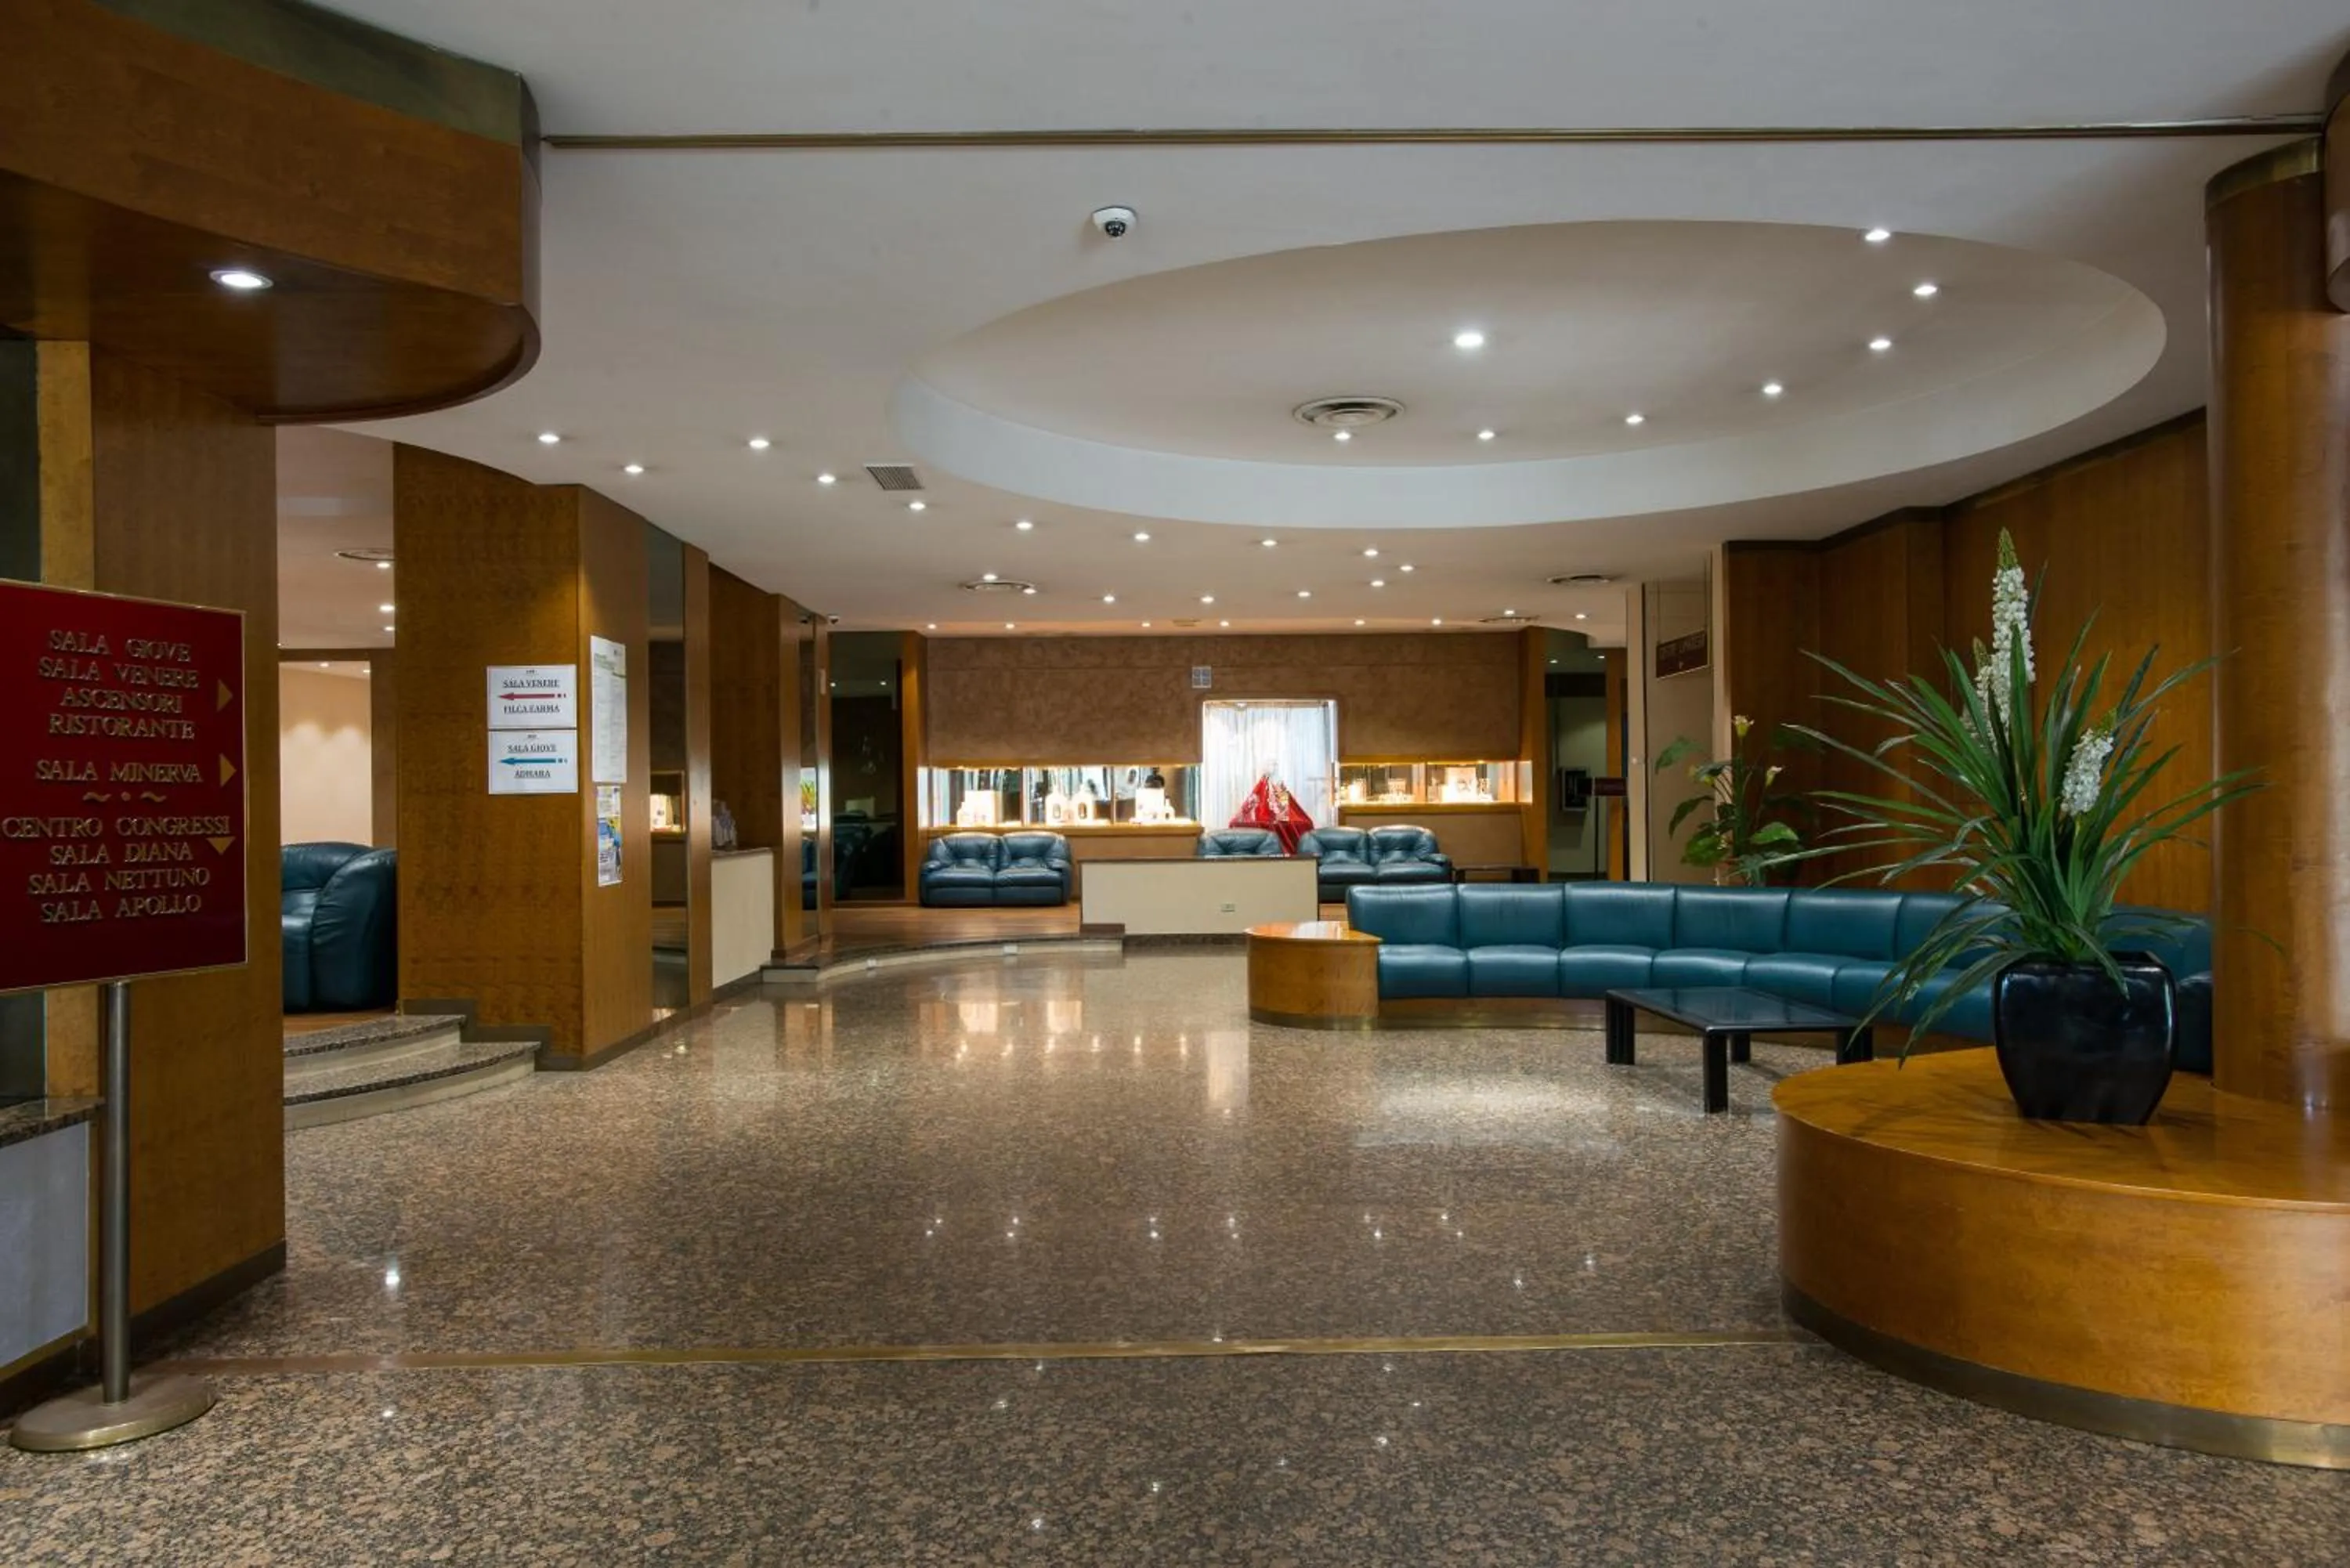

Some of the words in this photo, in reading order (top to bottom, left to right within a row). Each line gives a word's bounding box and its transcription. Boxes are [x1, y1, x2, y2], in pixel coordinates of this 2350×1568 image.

[49, 630, 111, 655] SALA
[125, 638, 192, 663] GIOVE
[38, 656, 102, 681] SALA
[114, 663, 200, 688] VENERE
[503, 679, 525, 688] SALA
[60, 686, 183, 714] ASCENSORI
[49, 713, 195, 739] RISTORANTE
[507, 744, 529, 753] SALA
[35, 759, 98, 782] SALA
[109, 764, 203, 783] MINERVA
[2, 817, 103, 839] CENTRO
[116, 816, 230, 836] CONGRESSI
[49, 844, 110, 865] SALA
[125, 841, 193, 862] DIANA
[27, 873, 92, 895] SALA
[104, 867, 210, 891] NETTUNO
[41, 900, 103, 923] SALA
[115, 894, 201, 918] APOLLO
